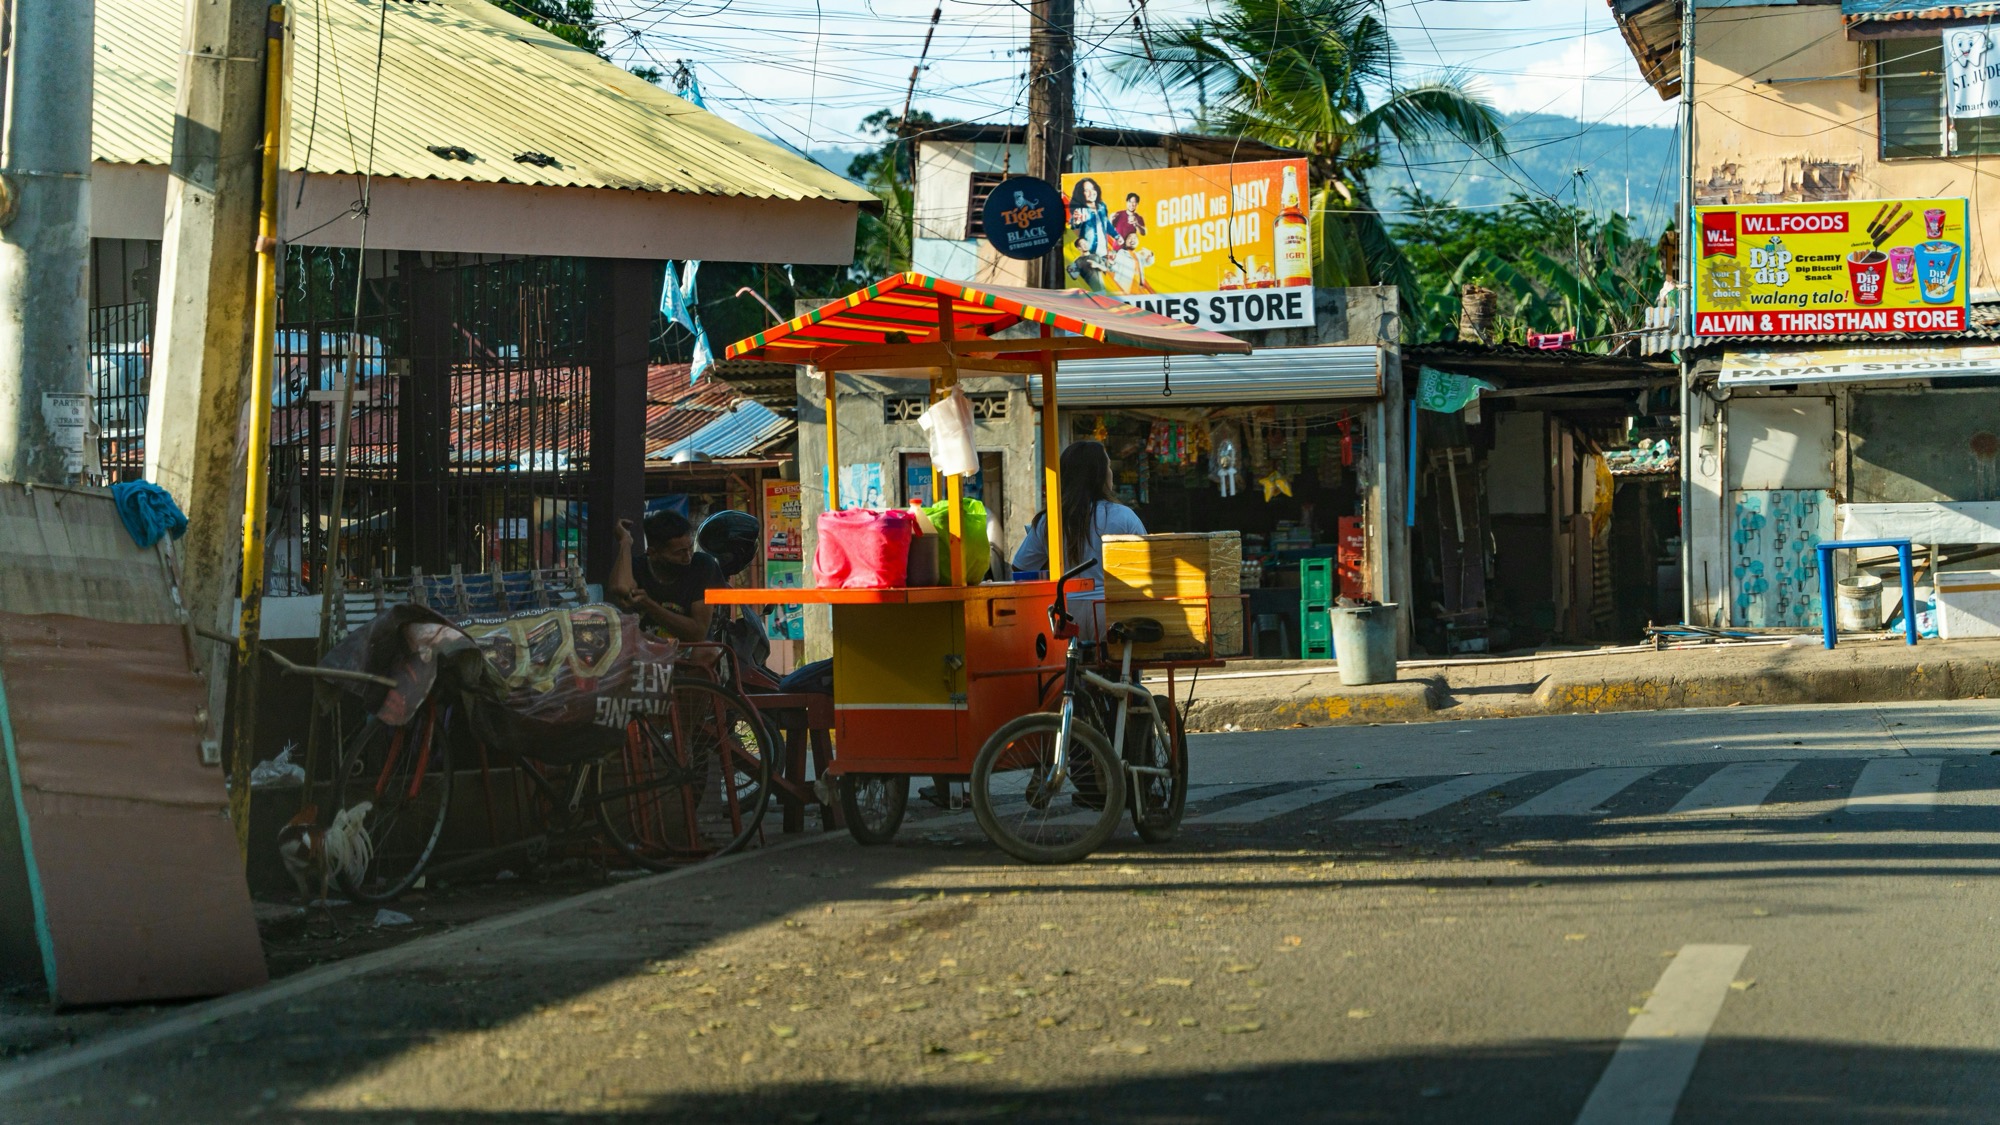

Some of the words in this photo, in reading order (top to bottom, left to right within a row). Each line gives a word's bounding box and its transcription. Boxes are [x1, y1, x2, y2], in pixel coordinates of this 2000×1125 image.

[1952, 74, 1970, 92] ST.
[1956, 102, 1984, 112] Smart
[1156, 192, 1205, 228] GAAN
[1209, 195, 1227, 217] NG
[1231, 178, 1271, 213] MAY
[1001, 205, 1045, 229] Tiger
[1007, 226, 1047, 242] BLACK
[1174, 212, 1260, 258] KASAMA
[1706, 230, 1735, 242] W.L.
[1009, 240, 1033, 251] STRONG
[1033, 238, 1050, 246] BEER
[1795, 254, 1841, 262] Creamy
[1733, 270, 1742, 288] 1
[1713, 289, 1741, 298] choice
[1750, 291, 1808, 307] walang
[1812, 289, 1850, 304] talo!
[1209, 292, 1303, 324] STORE
[1700, 314, 1754, 333] ALVIN
[1760, 315, 1773, 331] &
[1778, 312, 1887, 331] THRISTHAN
[1893, 310, 1958, 329] STORE
[1732, 364, 1848, 378] PAPAT
[1862, 360, 1992, 371] STORE
[475, 617, 507, 625] ENGINE
